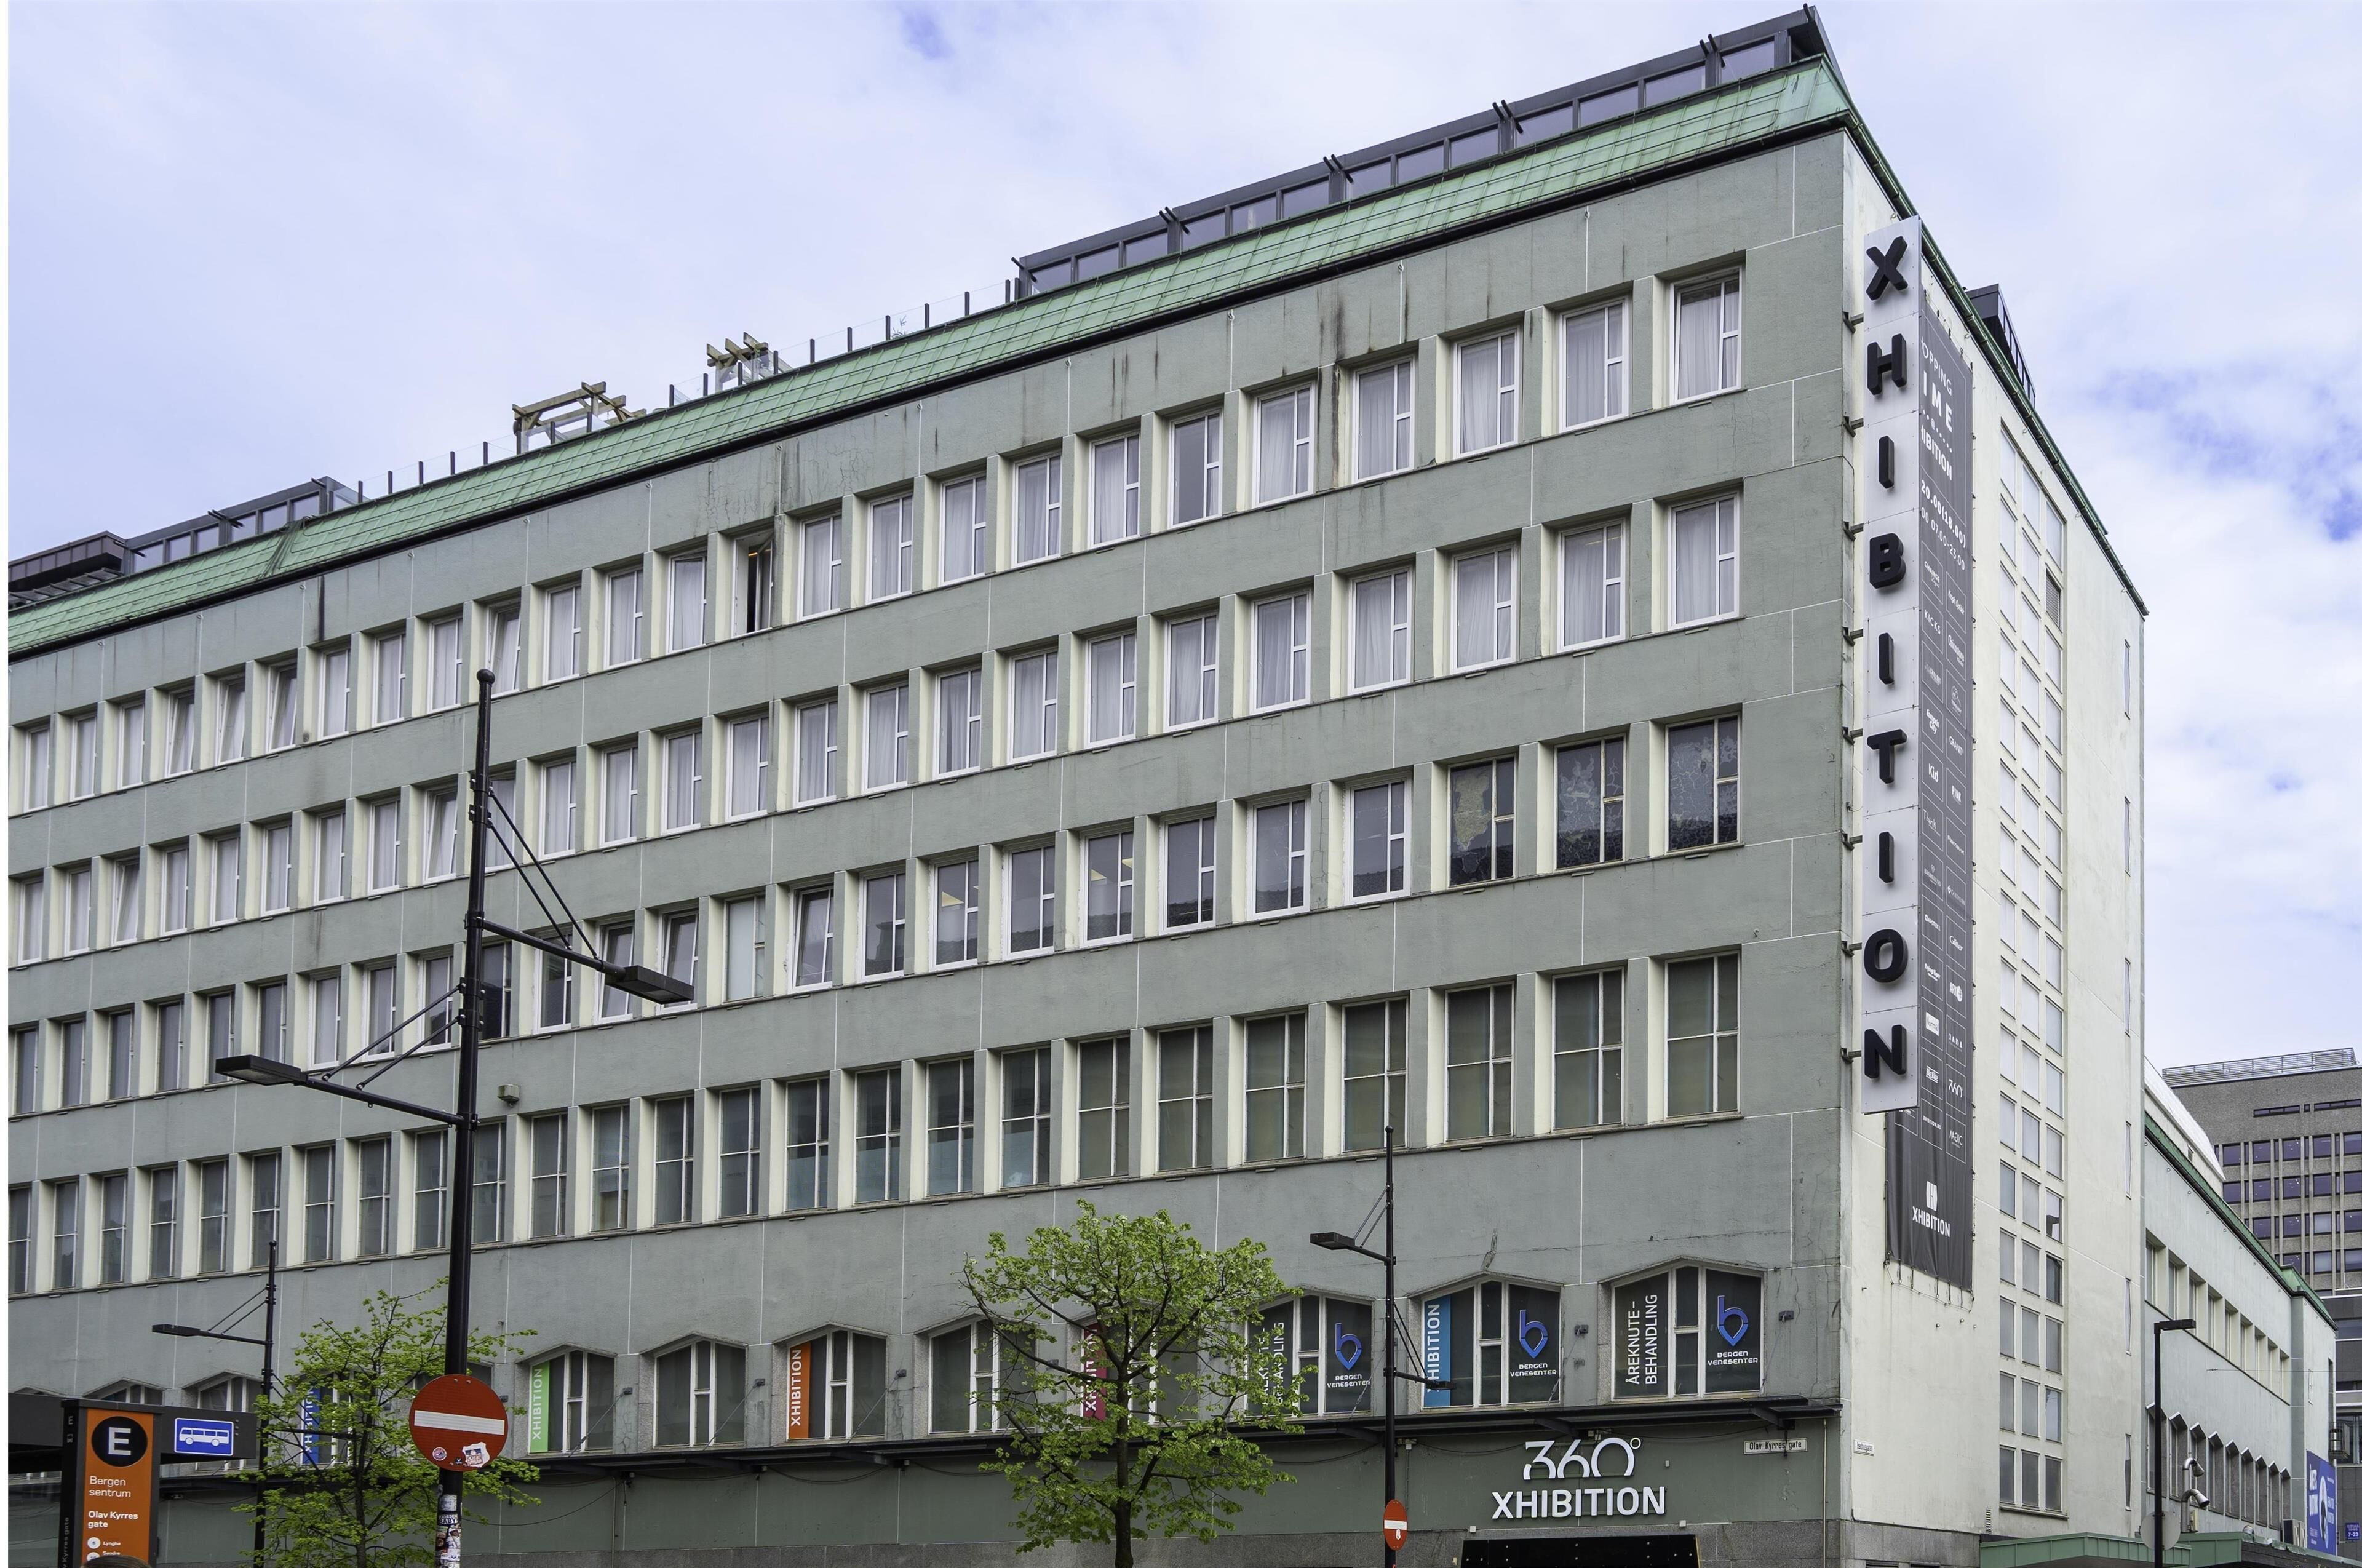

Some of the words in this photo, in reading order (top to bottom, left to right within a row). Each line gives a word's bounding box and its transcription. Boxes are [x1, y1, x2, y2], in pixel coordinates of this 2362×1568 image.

[1922, 337, 1952, 396] OPPING
[1923, 370, 1952, 432] IME
[1921, 424, 1952, 480] IBITION
[1925, 610, 1940, 634] KICKS
[1864, 236, 1908, 1079] XHIBITION
[1928, 763, 1939, 782] Kid
[1912, 1206, 1950, 1238] XHIBITION
[1626, 1301, 1640, 1385] ÅREKNUTE-
[1645, 1295, 1657, 1384] BEHANDLING
[533, 1368, 542, 1440] XHIBITION
[791, 1350, 801, 1427] XHIBITION
[68, 1416, 73, 1425] E
[108, 1427, 132, 1455] E
[1765, 1441, 1786, 1451] Kyrres
[1789, 1441, 1802, 1450] gate
[89, 1489, 131, 1497] sentrum
[90, 1476, 126, 1487] Bergen
[1492, 1486, 1665, 1519] XHIBITION
[88, 1520, 108, 1529] gate
